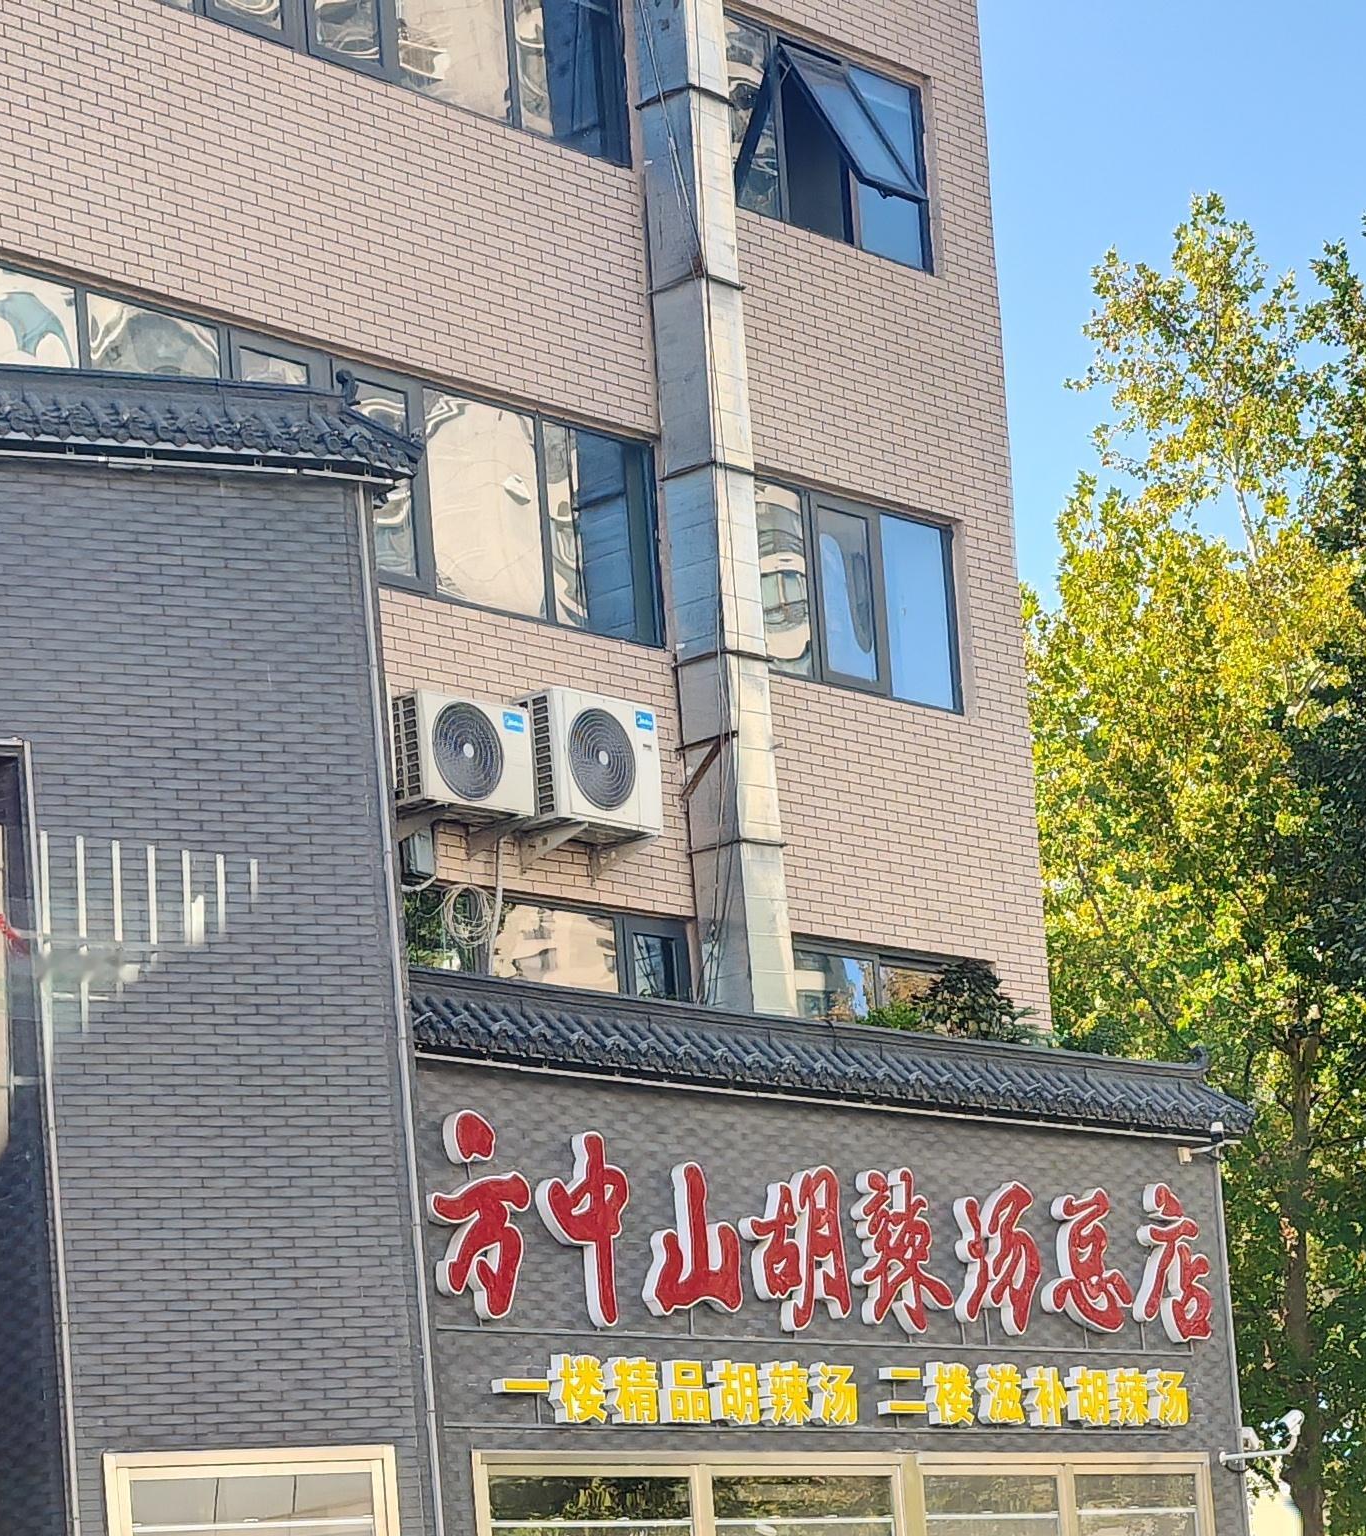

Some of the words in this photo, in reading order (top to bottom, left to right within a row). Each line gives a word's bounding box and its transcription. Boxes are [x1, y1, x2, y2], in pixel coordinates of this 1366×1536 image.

[428, 1108, 1213, 1343] 方中山胡辣汤总店
[492, 1353, 858, 1426] 一楼精品胡辣汤
[877, 1361, 1189, 1427] 二楼滋补胡辣汤
